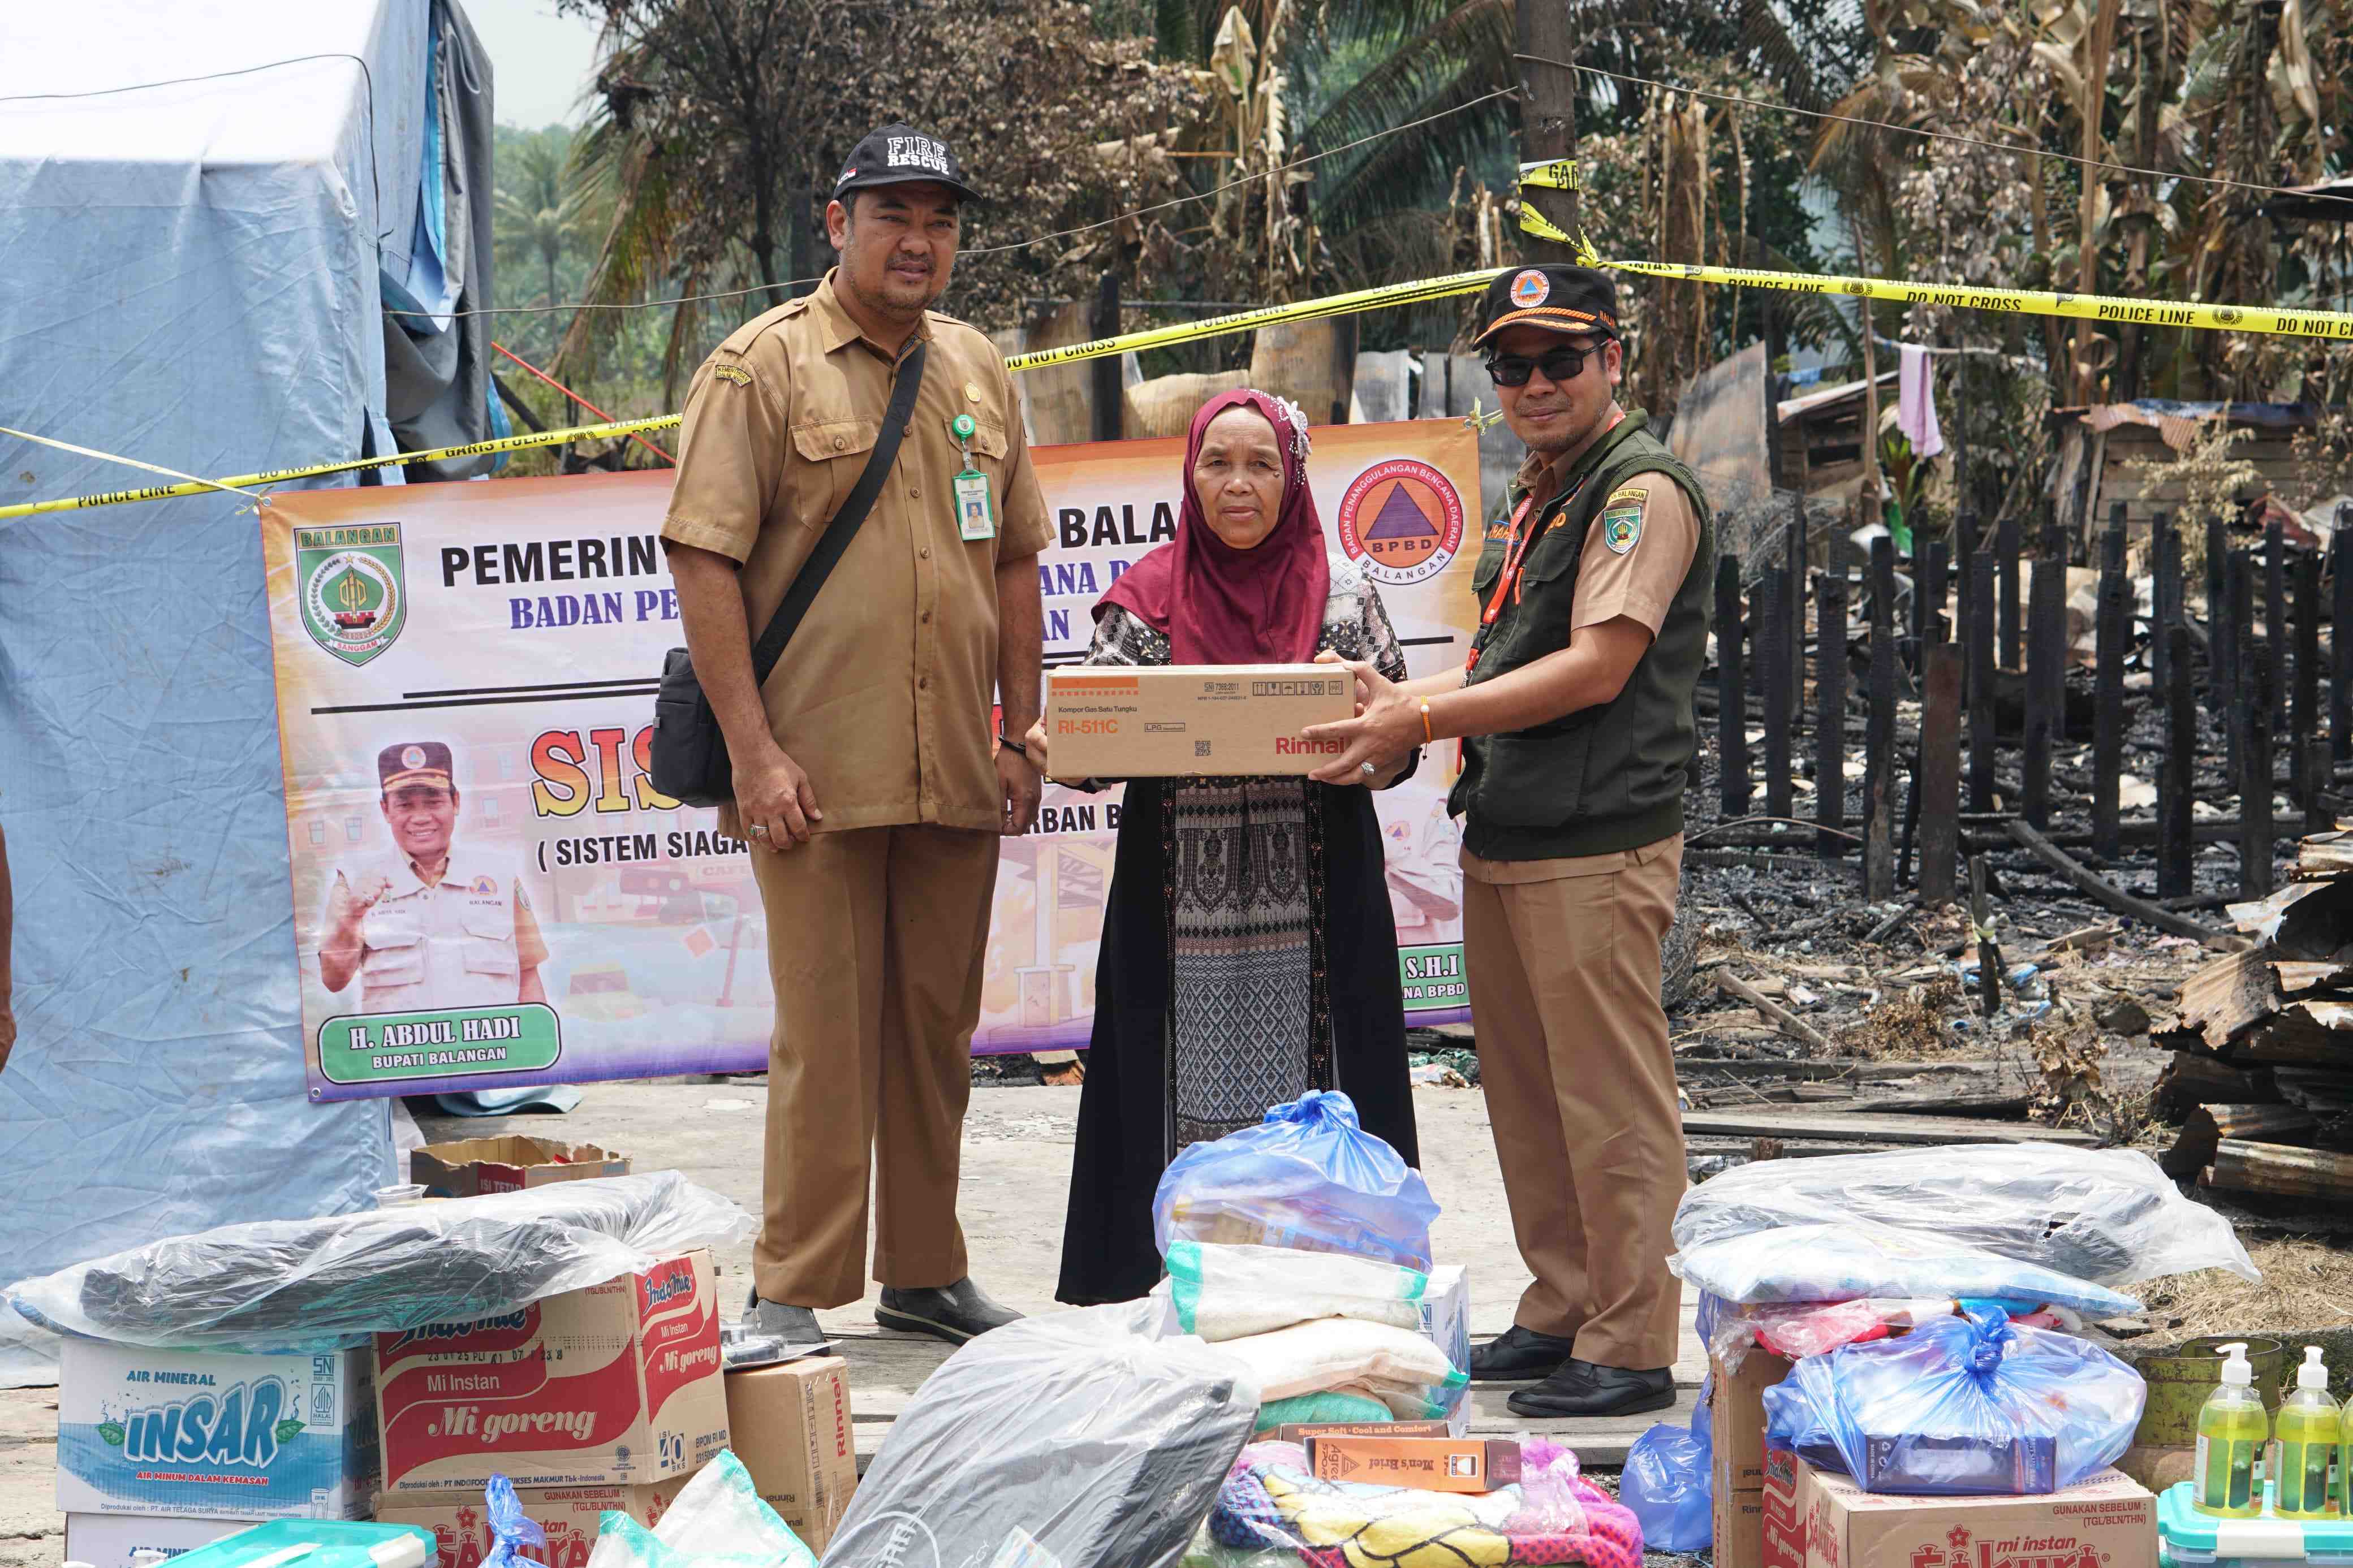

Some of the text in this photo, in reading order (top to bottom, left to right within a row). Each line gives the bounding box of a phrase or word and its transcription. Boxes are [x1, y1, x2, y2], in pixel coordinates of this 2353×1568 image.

[887, 136, 947, 162] FIRE
[887, 154, 950, 175] RESCUE
[1907, 291, 2022, 310] DO NOT CROSS
[2098, 304, 2195, 325] POLICE LINE
[2276, 318, 2298, 332] DO
[2303, 319, 2334, 334] NOT
[1028, 349, 1058, 364] NOT
[1063, 339, 1117, 357] CROSS
[77, 485, 176, 508] POLICE LINE
[1344, 464, 1418, 518] PENANGGULANGAN
[1419, 468, 1454, 506] BENCANA
[1446, 506, 1459, 548] DAERAH
[301, 527, 395, 547] BALANGAN
[441, 500, 1183, 588] PEMERIN BALA
[1343, 520, 1358, 554] BADAN
[1372, 539, 1432, 553] BPBD
[1361, 552, 1446, 580] BALANGAN
[510, 589, 622, 629] BADAN
[337, 640, 378, 653] SANGGAM
[1114, 705, 1137, 714] Tungku
[1058, 719, 1118, 735] RI-511C
[1275, 737, 1344, 755] Rinnai
[556, 833, 657, 865] SISTEM
[666, 830, 748, 858] SIAGA
[1427, 983, 1466, 998] BPBD
[349, 1016, 522, 1050] H. ABDUL HADI
[372, 1047, 507, 1070] BUPATI BALANGAN
[643, 1271, 692, 1317] Indomie
[660, 1323, 688, 1338] Mi Instan
[313, 1357, 335, 1374] SNI
[659, 1345, 717, 1373] Mi goreng
[126, 1370, 217, 1386] AIR MINERAL
[427, 1375, 500, 1393] Mi Instan
[125, 1375, 285, 1468] INSAR
[428, 1405, 597, 1444] Mi goreng
[831, 1376, 846, 1457] Rinnai
[696, 1429, 727, 1448] BPOM RI MD
[1298, 1427, 1326, 1436] Super
[1374, 1426, 1393, 1434] and
[1393, 1424, 1432, 1433] Comfort
[660, 1433, 685, 1468] 40
[672, 1463, 686, 1472] BKS
[1368, 1458, 1434, 1471] Men's Brief
[135, 1470, 269, 1485] AIR MINUM DALAM KEMASAN
[533, 1475, 564, 1484] MAKMUR
[544, 1489, 620, 1501] GUNAKAN SEBELUM
[100, 1502, 132, 1513] Diproduksi
[572, 1501, 626, 1513] (TGL/BLN/THN)
[2053, 1502, 2141, 1515] GUNAKAN SEBELUM
[544, 1519, 567, 1534] tan
[2083, 1513, 2147, 1528] (TGL/BLN/THN)
[1996, 1536, 2076, 1553] mi instan
